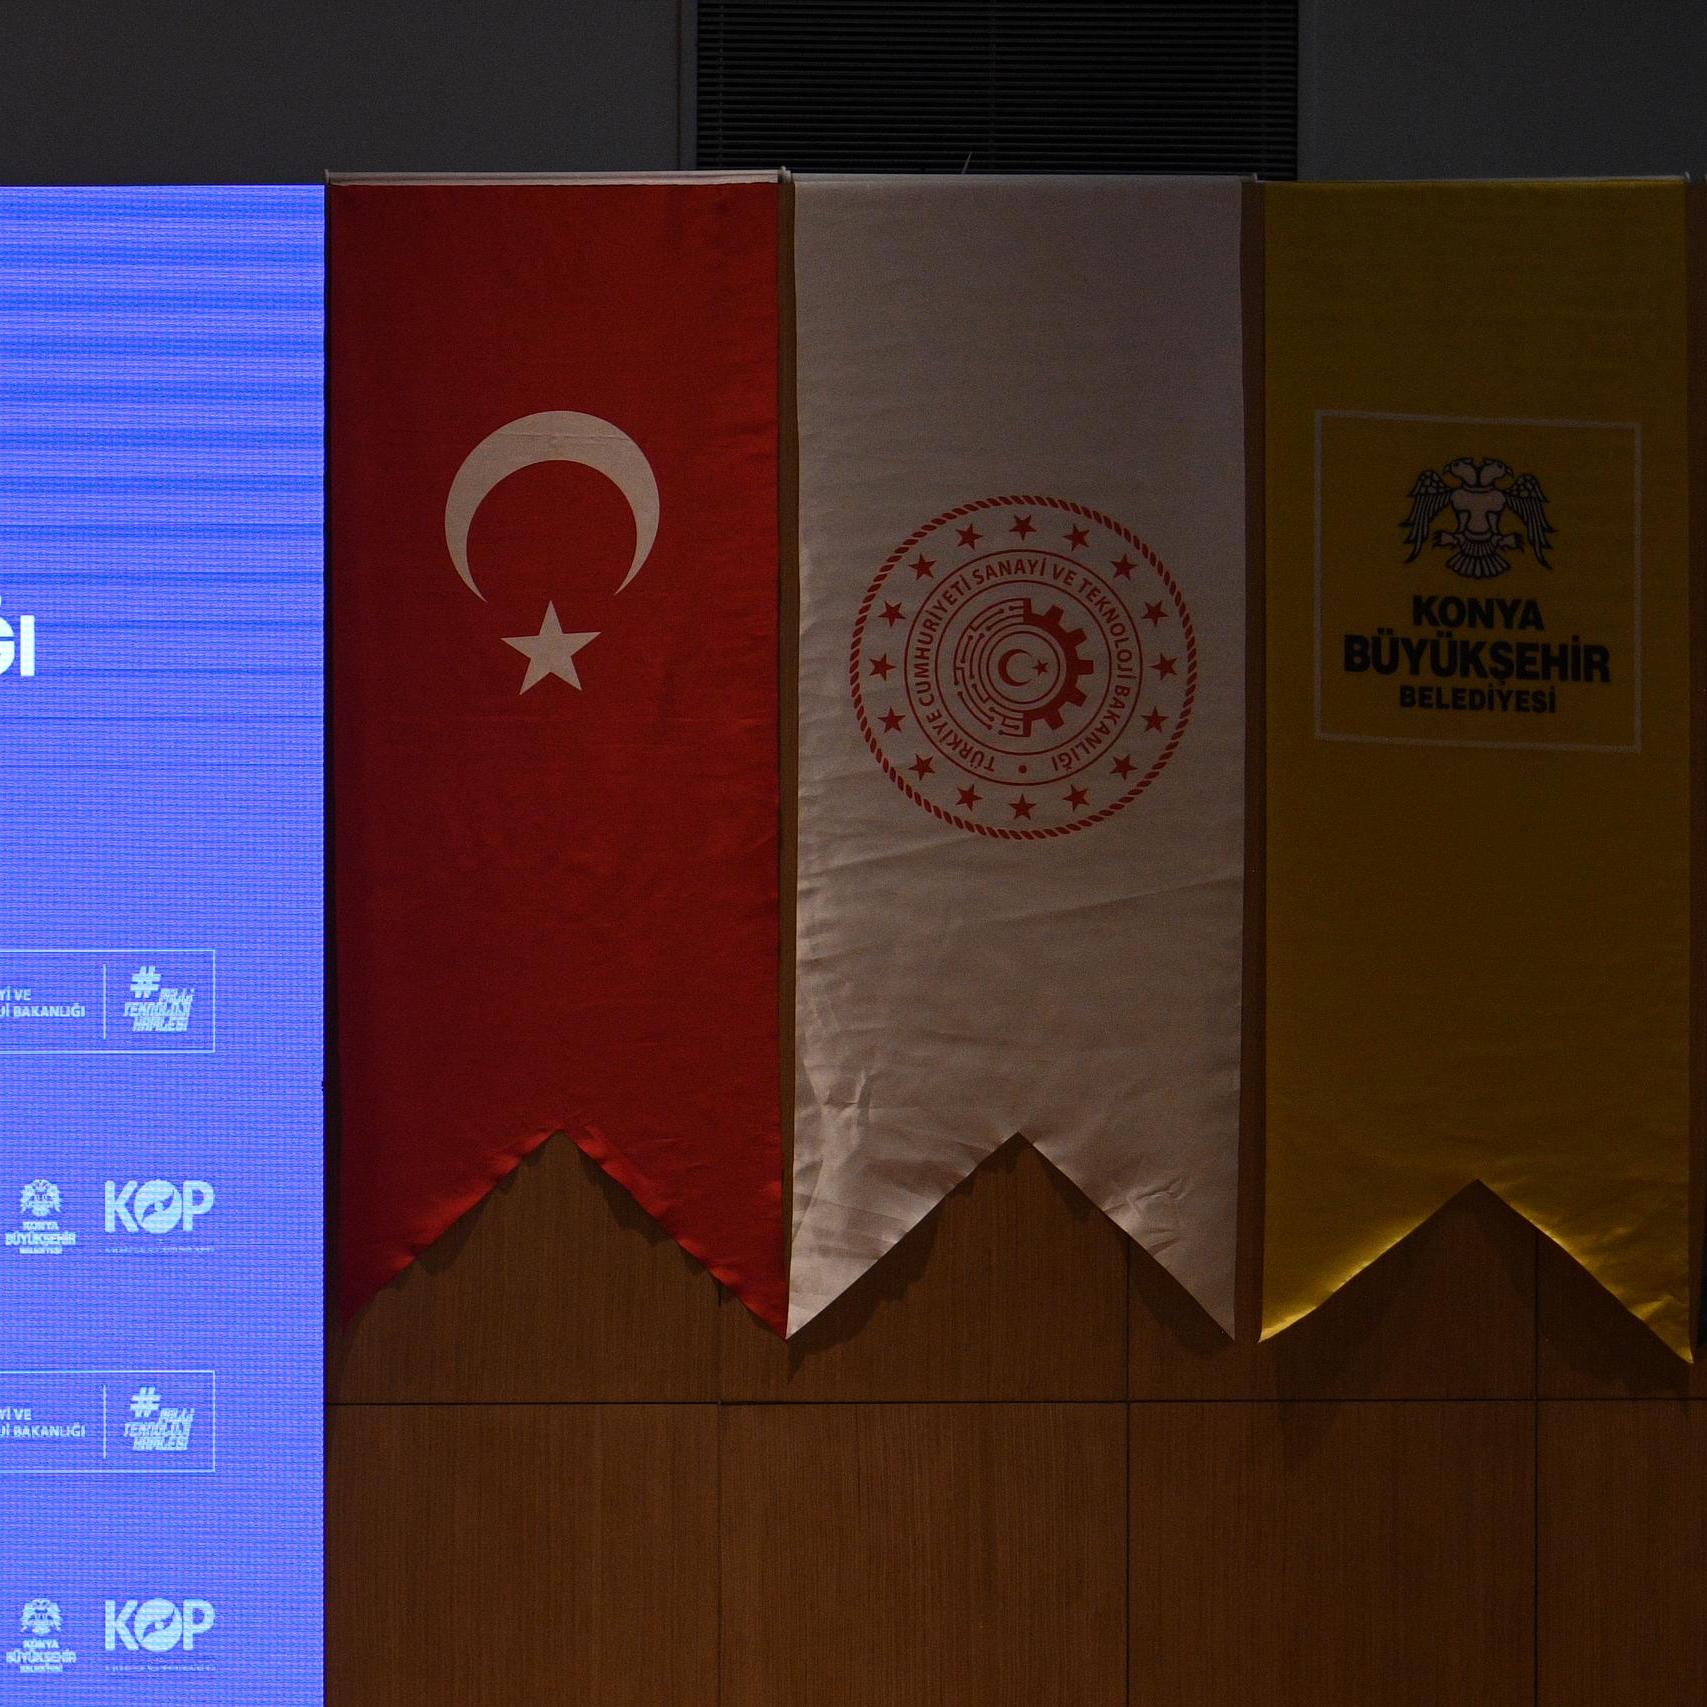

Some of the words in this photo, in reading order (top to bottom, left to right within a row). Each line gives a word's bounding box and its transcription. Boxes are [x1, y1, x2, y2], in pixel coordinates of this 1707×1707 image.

[972, 557, 1046, 586] SANAYİ
[1052, 563, 1077, 586] VE
[1077, 577, 1137, 681] TEKNOLOJİ
[1412, 595, 1545, 632] KONYA
[914, 577, 972, 707] CUMHURİYETİ
[1344, 627, 1611, 684] BÜYÜKŞEHİR
[1399, 683, 1557, 715] BELEDİYESİ
[925, 706, 996, 774] TÜRKİYE
[1052, 686, 1131, 773] BAKANLIĞI
[13, 1002, 85, 1018] BAKANLIĞI
[14, 989, 31, 1001] VE
[105, 1179, 215, 1233] KOP
[13, 1409, 31, 1420] VE
[13, 1423, 86, 1438] BAKANLIĞI
[105, 1598, 215, 1652] KOP
